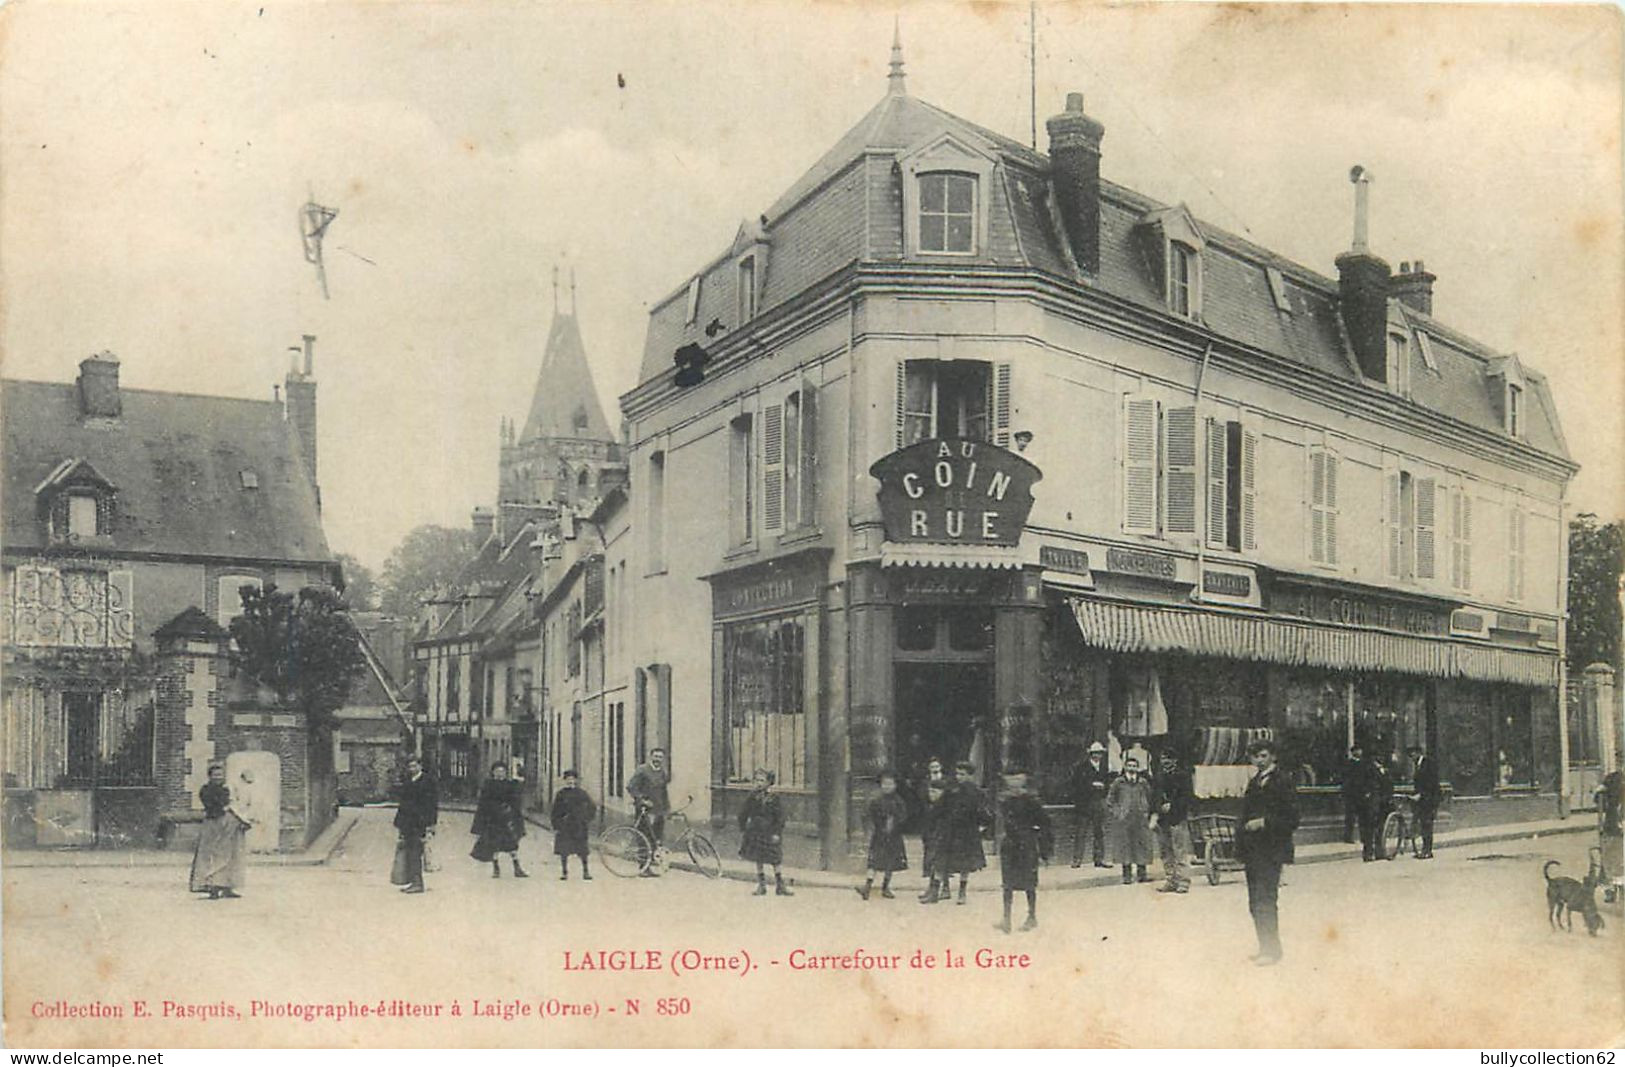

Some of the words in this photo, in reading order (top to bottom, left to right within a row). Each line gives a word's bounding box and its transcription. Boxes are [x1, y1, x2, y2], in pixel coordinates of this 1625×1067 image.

[937, 441, 976, 458] AU
[903, 461, 1011, 501] COIN
[911, 509, 1000, 539] RUE
[1330, 597, 1366, 625] COIN
